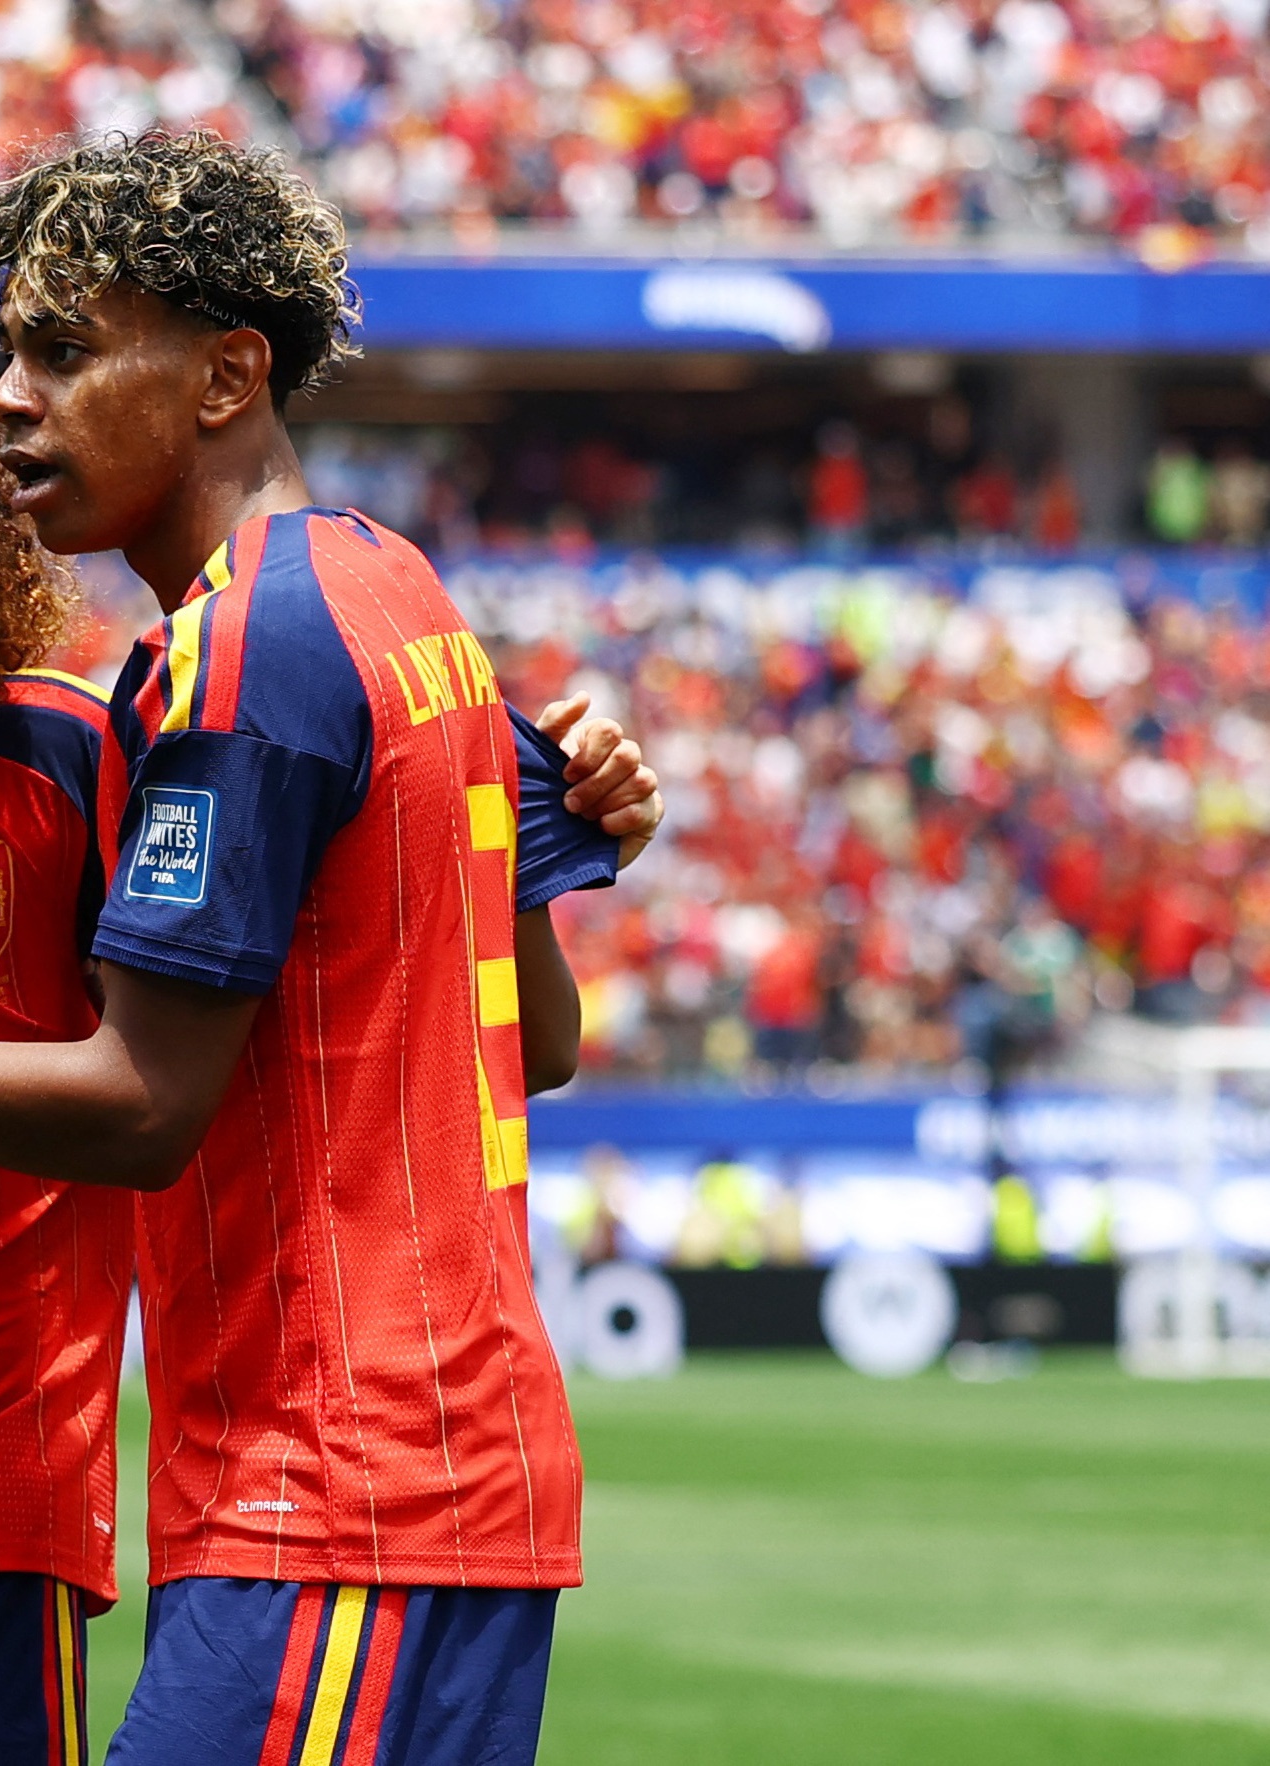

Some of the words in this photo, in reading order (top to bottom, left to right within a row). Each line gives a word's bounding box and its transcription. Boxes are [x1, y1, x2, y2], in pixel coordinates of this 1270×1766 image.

[152, 803, 197, 823] FOOTBALL
[146, 822, 197, 849] UNITES
[138, 846, 157, 866] the
[158, 849, 199, 874] World
[152, 872, 176, 884] FIFA
[237, 1500, 294, 1513] CLIMACOOL
